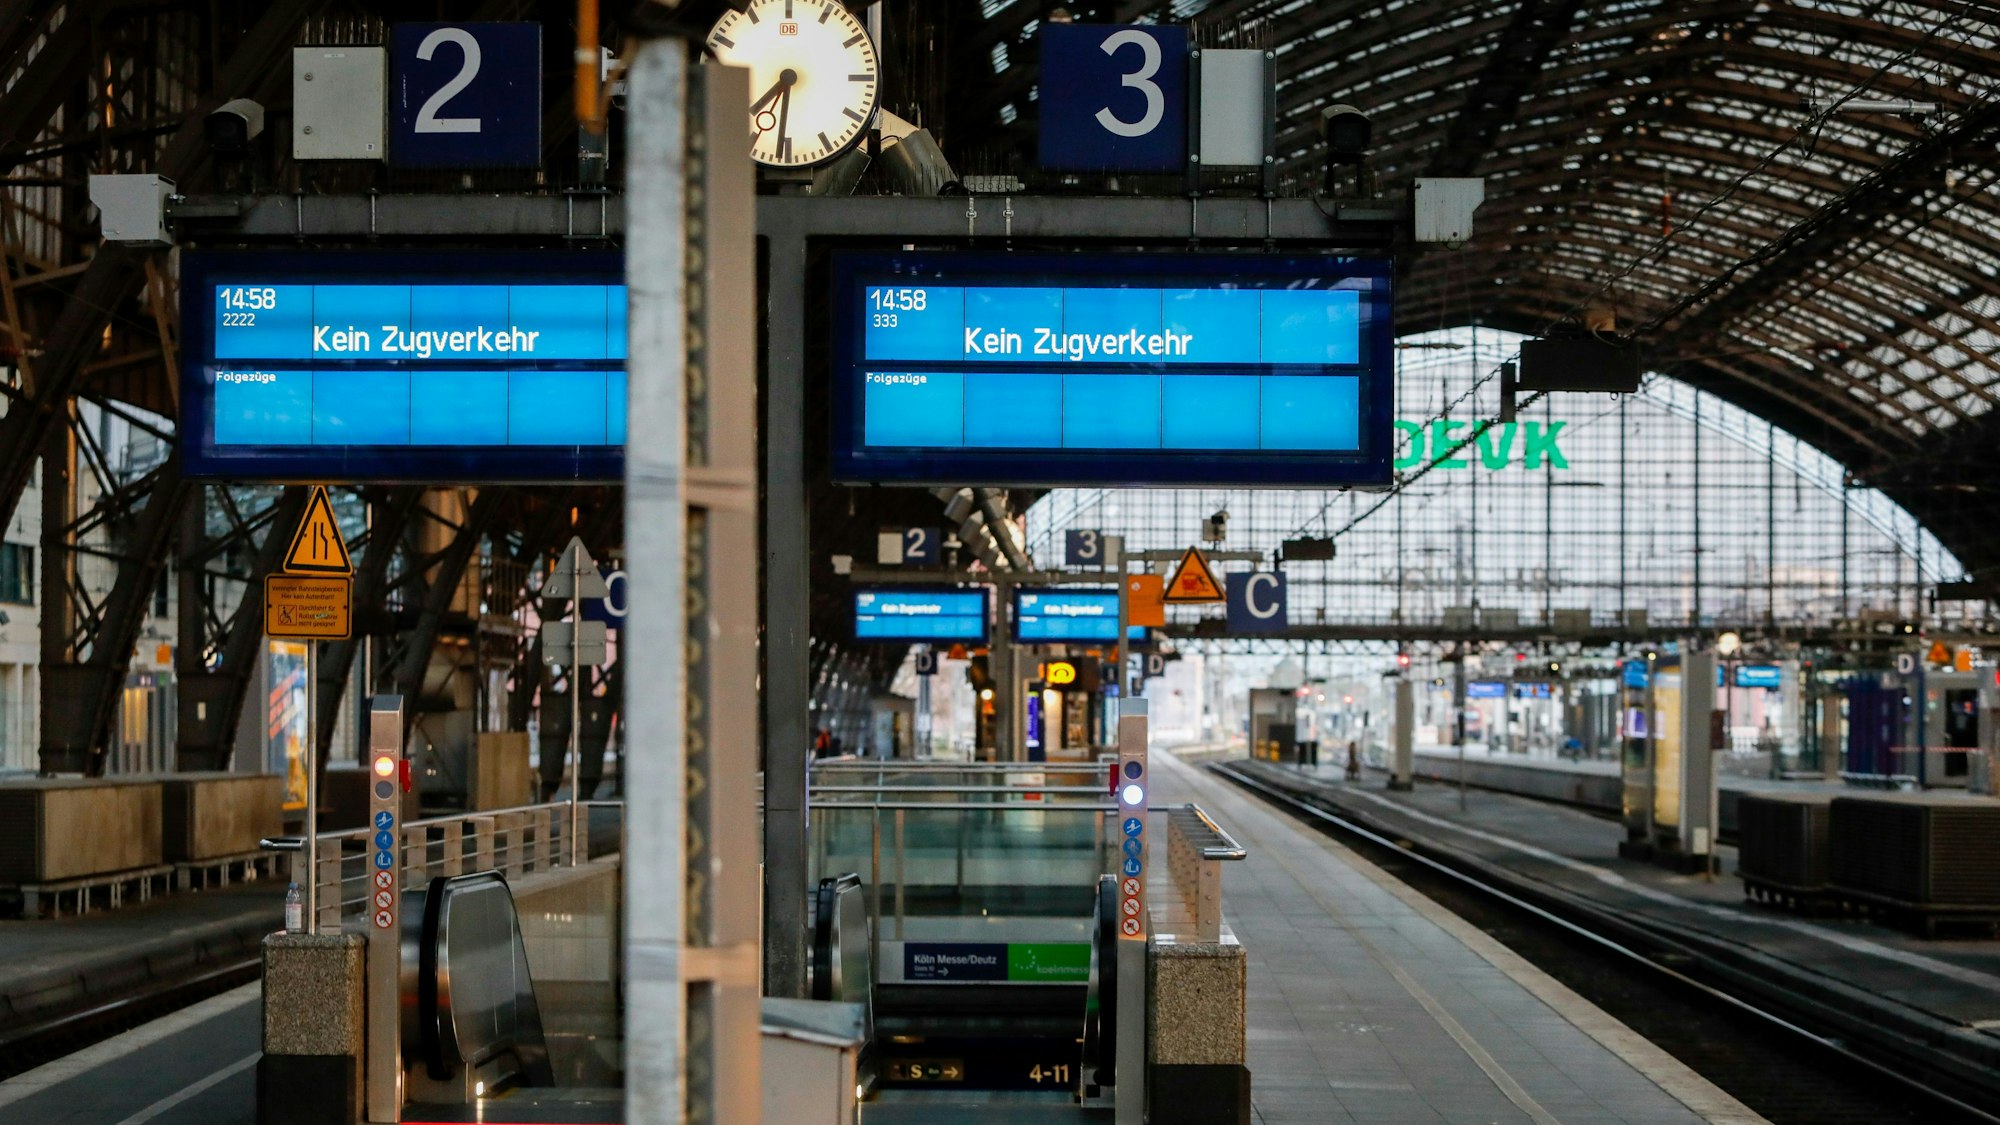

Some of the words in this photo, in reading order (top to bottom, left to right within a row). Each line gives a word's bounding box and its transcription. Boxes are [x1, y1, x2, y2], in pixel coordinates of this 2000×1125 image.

[781, 24, 796, 34] DB
[415, 28, 481, 133] 2
[1095, 29, 1165, 138] 3
[220, 288, 276, 310] 14:58
[870, 289, 926, 311] 14:58
[222, 313, 255, 327] 2222
[873, 314, 898, 328] 333
[313, 326, 370, 352] Kein
[381, 326, 540, 358] Zugverkehr
[964, 327, 1022, 354] Kein
[1034, 328, 1193, 361] Zugverkehr
[215, 371, 276, 384] Folgezüge
[866, 372, 927, 386] Folgezüge
[1393, 420, 1569, 470] DEVK
[907, 527, 927, 558] 2
[1078, 529, 1098, 559] 3
[1245, 572, 1280, 619] C
[1149, 656, 1163, 674] D
[1898, 653, 1915, 675] D
[913, 953, 935, 965] Köln
[937, 954, 997, 965] Messe/Deutz
[910, 1064, 923, 1079] S
[1029, 1063, 1069, 1084] 4-11
